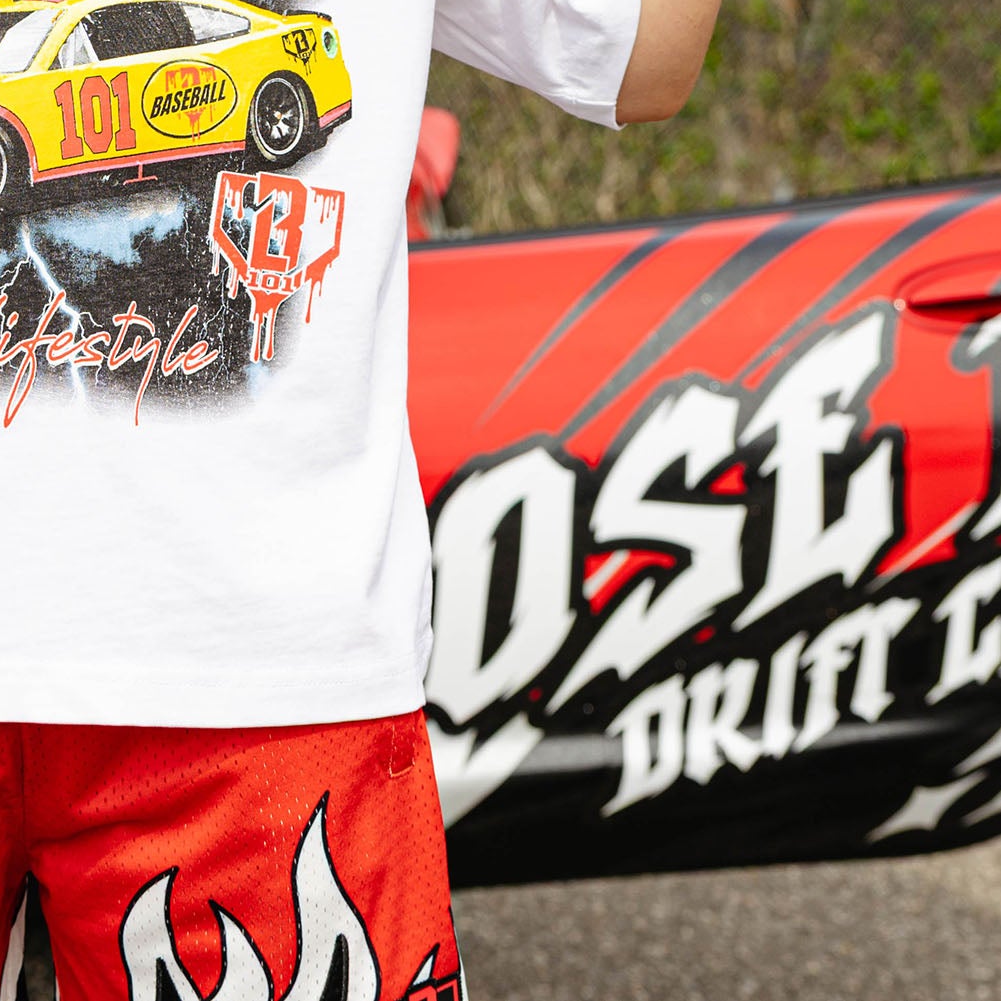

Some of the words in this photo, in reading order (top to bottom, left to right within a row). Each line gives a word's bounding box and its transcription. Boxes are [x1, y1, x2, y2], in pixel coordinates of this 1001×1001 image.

[54, 71, 136, 160] 101
[150, 80, 226, 120] BASEBALL
[247, 270, 296, 294] 101
[602, 597, 922, 817] DRIFT
